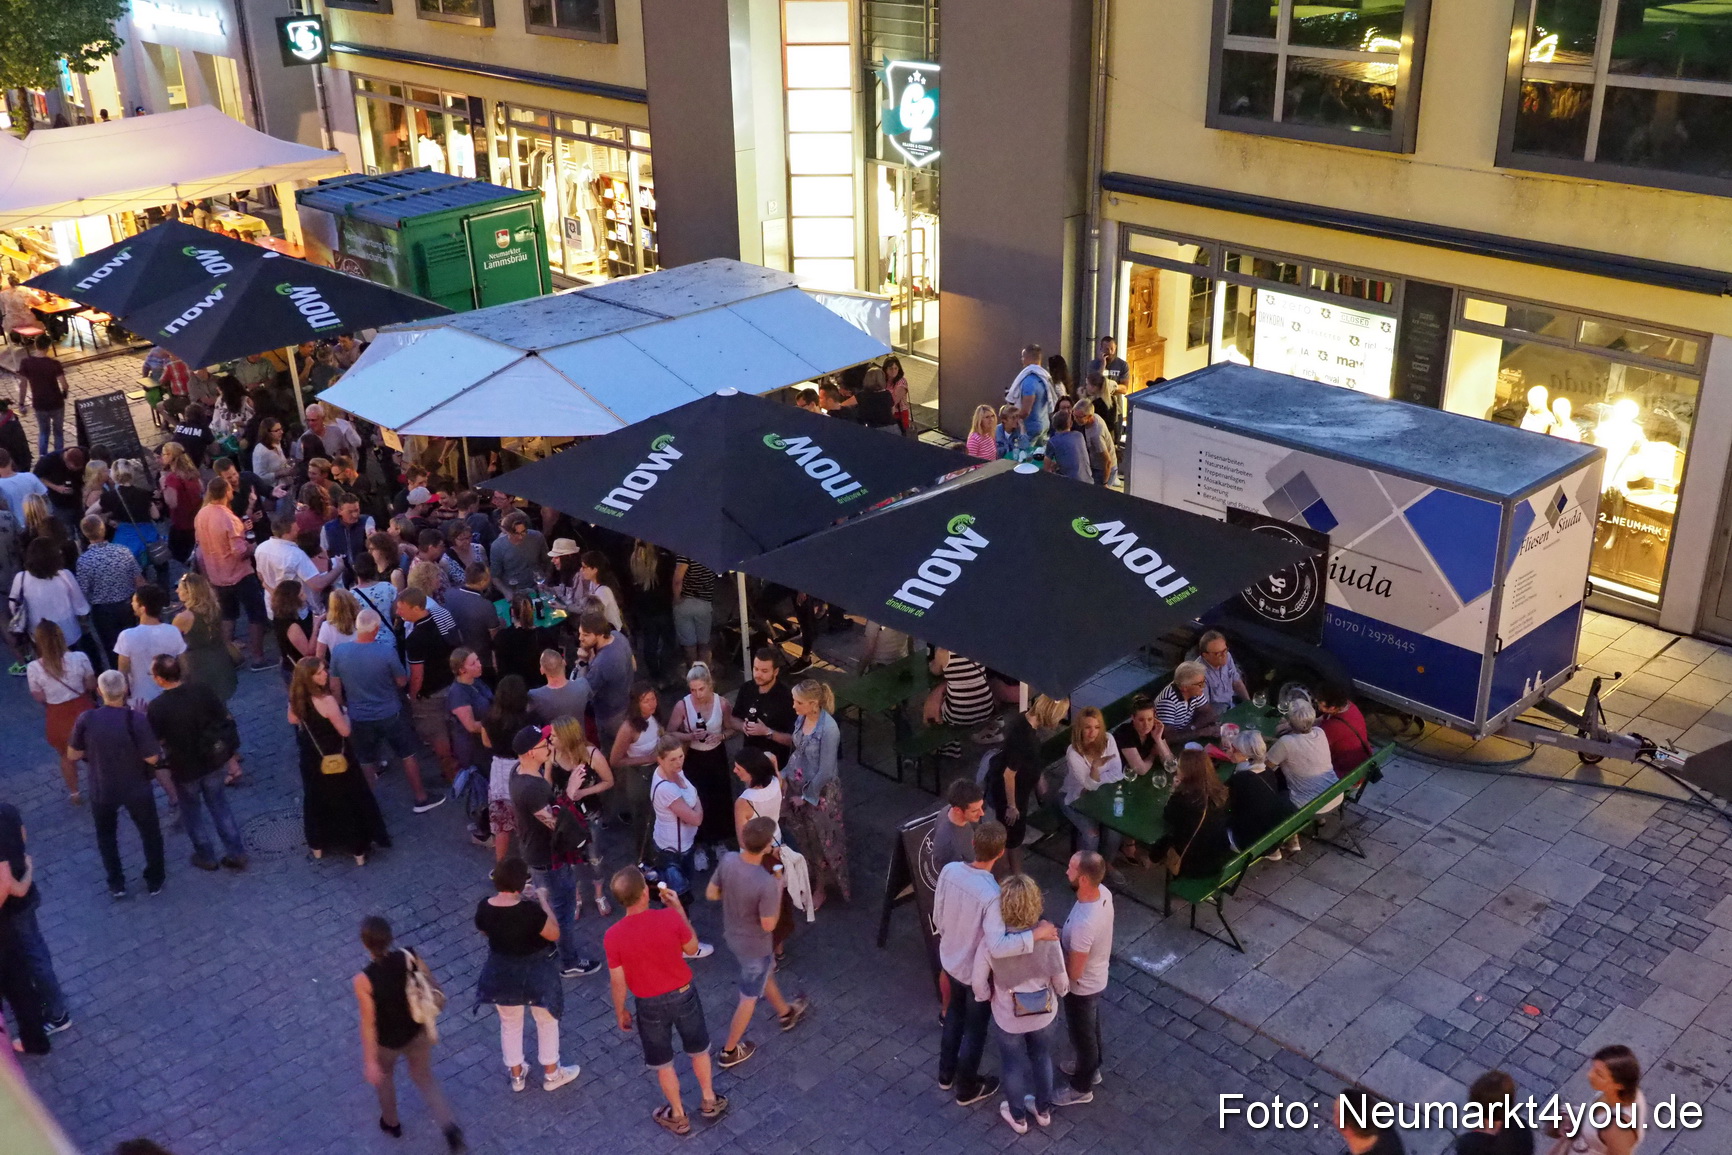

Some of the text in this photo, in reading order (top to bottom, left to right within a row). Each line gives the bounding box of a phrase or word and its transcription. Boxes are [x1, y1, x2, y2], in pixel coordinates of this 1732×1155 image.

[196, 248, 234, 277] ow
[483, 253, 528, 270] Lammsbräu
[488, 247, 522, 260] Neumarkter
[75, 249, 134, 290] now
[164, 287, 226, 334] now
[289, 286, 341, 328] now
[1341, 313, 1370, 327] CLOSED
[782, 436, 862, 498] now
[1204, 459, 1253, 478] Natursteinarbeiten
[1205, 451, 1245, 467] Fliesenarbeiten
[601, 443, 683, 511] now
[1204, 468, 1246, 484] Treppenanlagen
[1204, 476, 1243, 492] Mosaikarbeiten
[1203, 484, 1229, 498] Sanierung
[1203, 492, 1227, 505] Beratung
[1519, 529, 1550, 557] Fliesen
[1556, 509, 1582, 534] Siuda
[1599, 512, 1670, 537] 2_NEUMARKT
[893, 527, 990, 609] now
[1095, 520, 1190, 598] now
[1329, 556, 1393, 598] iuda
[885, 598, 925, 618] drinknow.de
[1165, 585, 1198, 607] drinknow.de
[1334, 617, 1359, 634] 0170
[1368, 628, 1416, 654] 2978445
